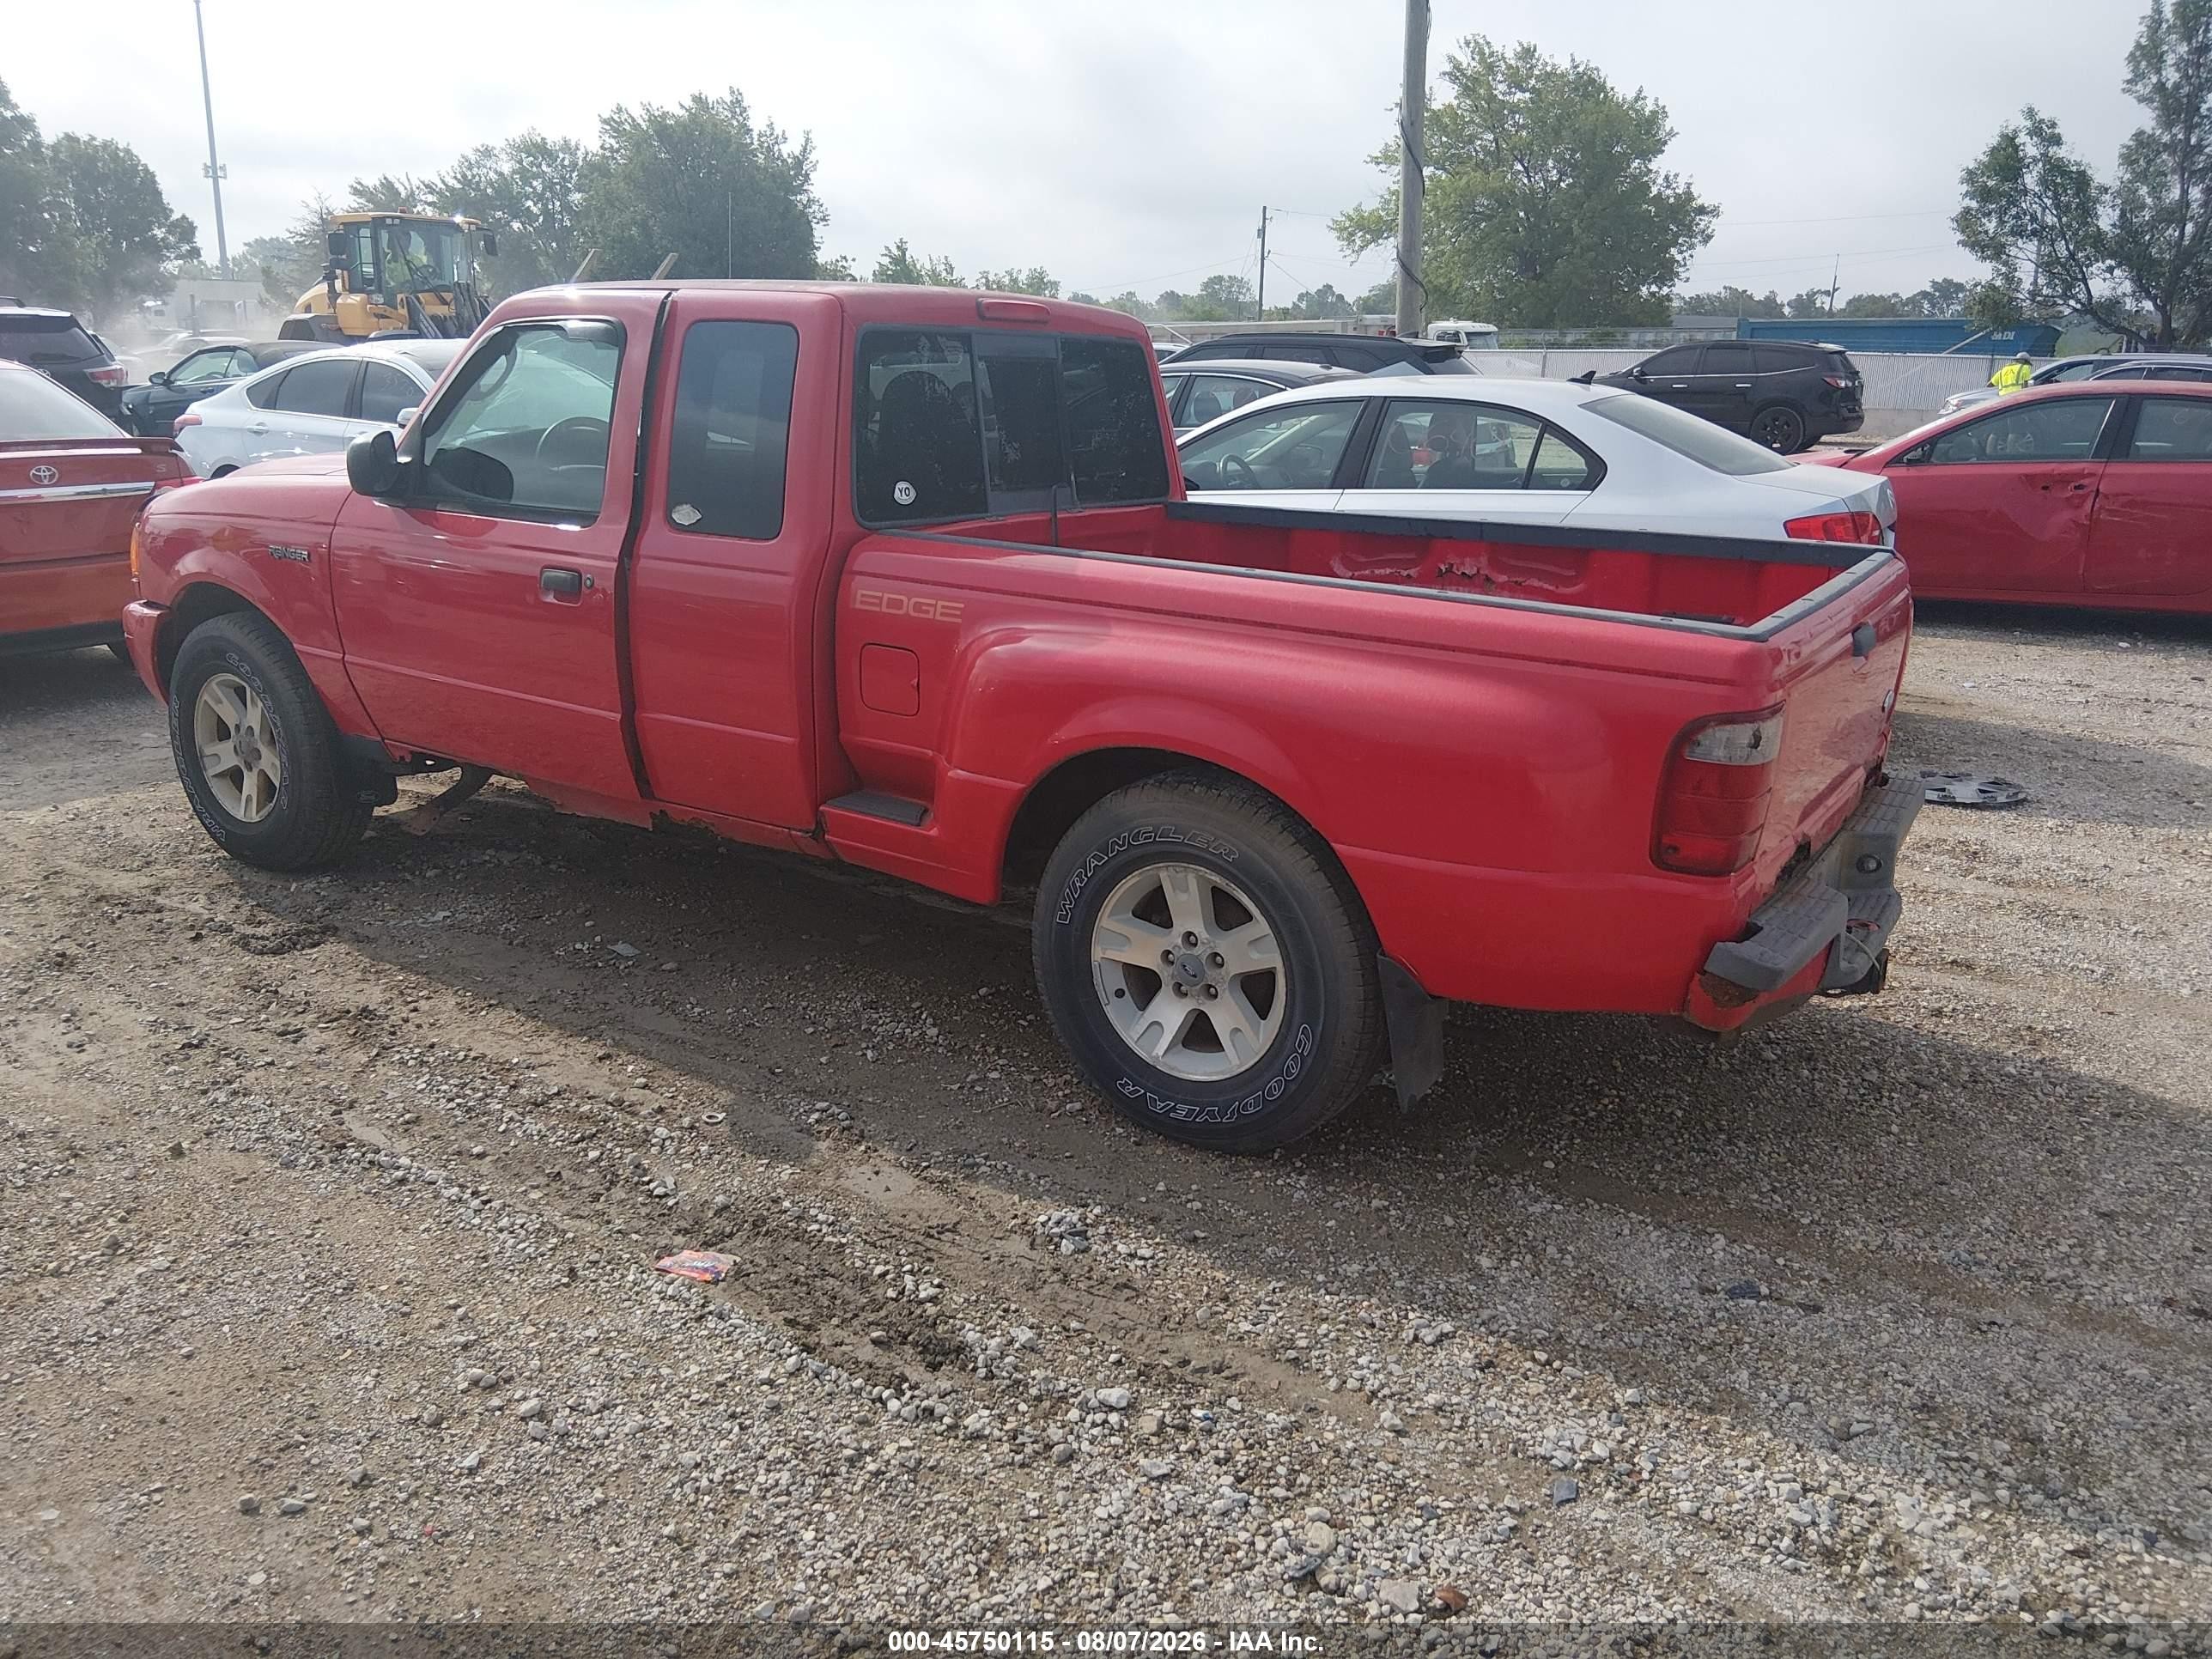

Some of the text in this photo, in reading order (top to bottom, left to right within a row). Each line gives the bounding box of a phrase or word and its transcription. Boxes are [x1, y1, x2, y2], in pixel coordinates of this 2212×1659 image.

[897, 486, 911, 498] YO
[268, 544, 309, 562] RANGER
[855, 589, 965, 623] EDGE
[1056, 825, 1238, 924] WRANGLER
[1116, 1023, 1312, 1122] GOODYEAR
